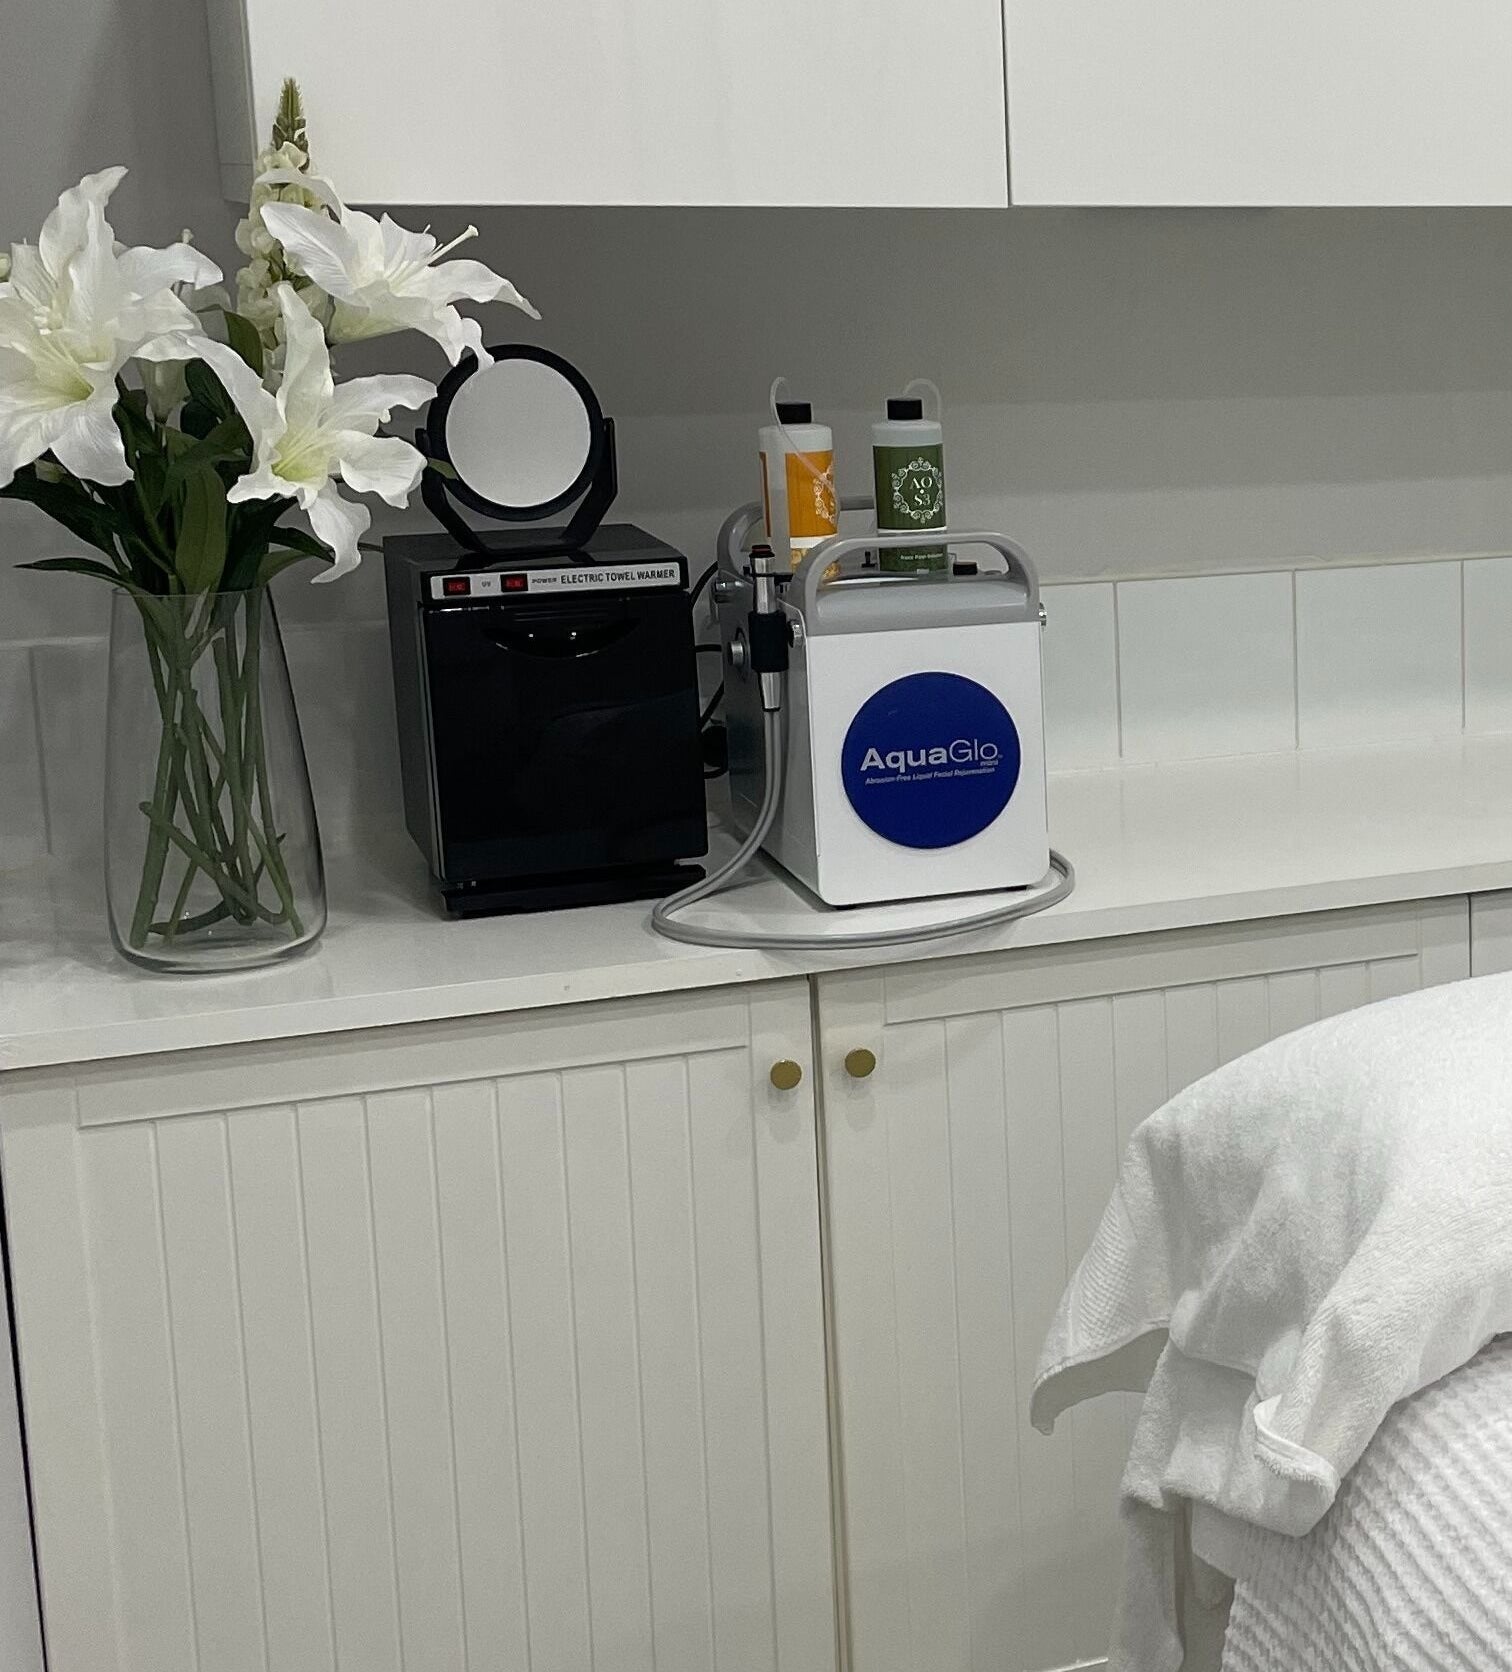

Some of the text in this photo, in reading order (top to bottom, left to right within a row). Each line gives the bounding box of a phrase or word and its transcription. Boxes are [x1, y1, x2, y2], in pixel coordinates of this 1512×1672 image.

[560, 569, 675, 585] ELECTRIC TOWEL WARMER
[860, 738, 998, 774] AquaGlo
